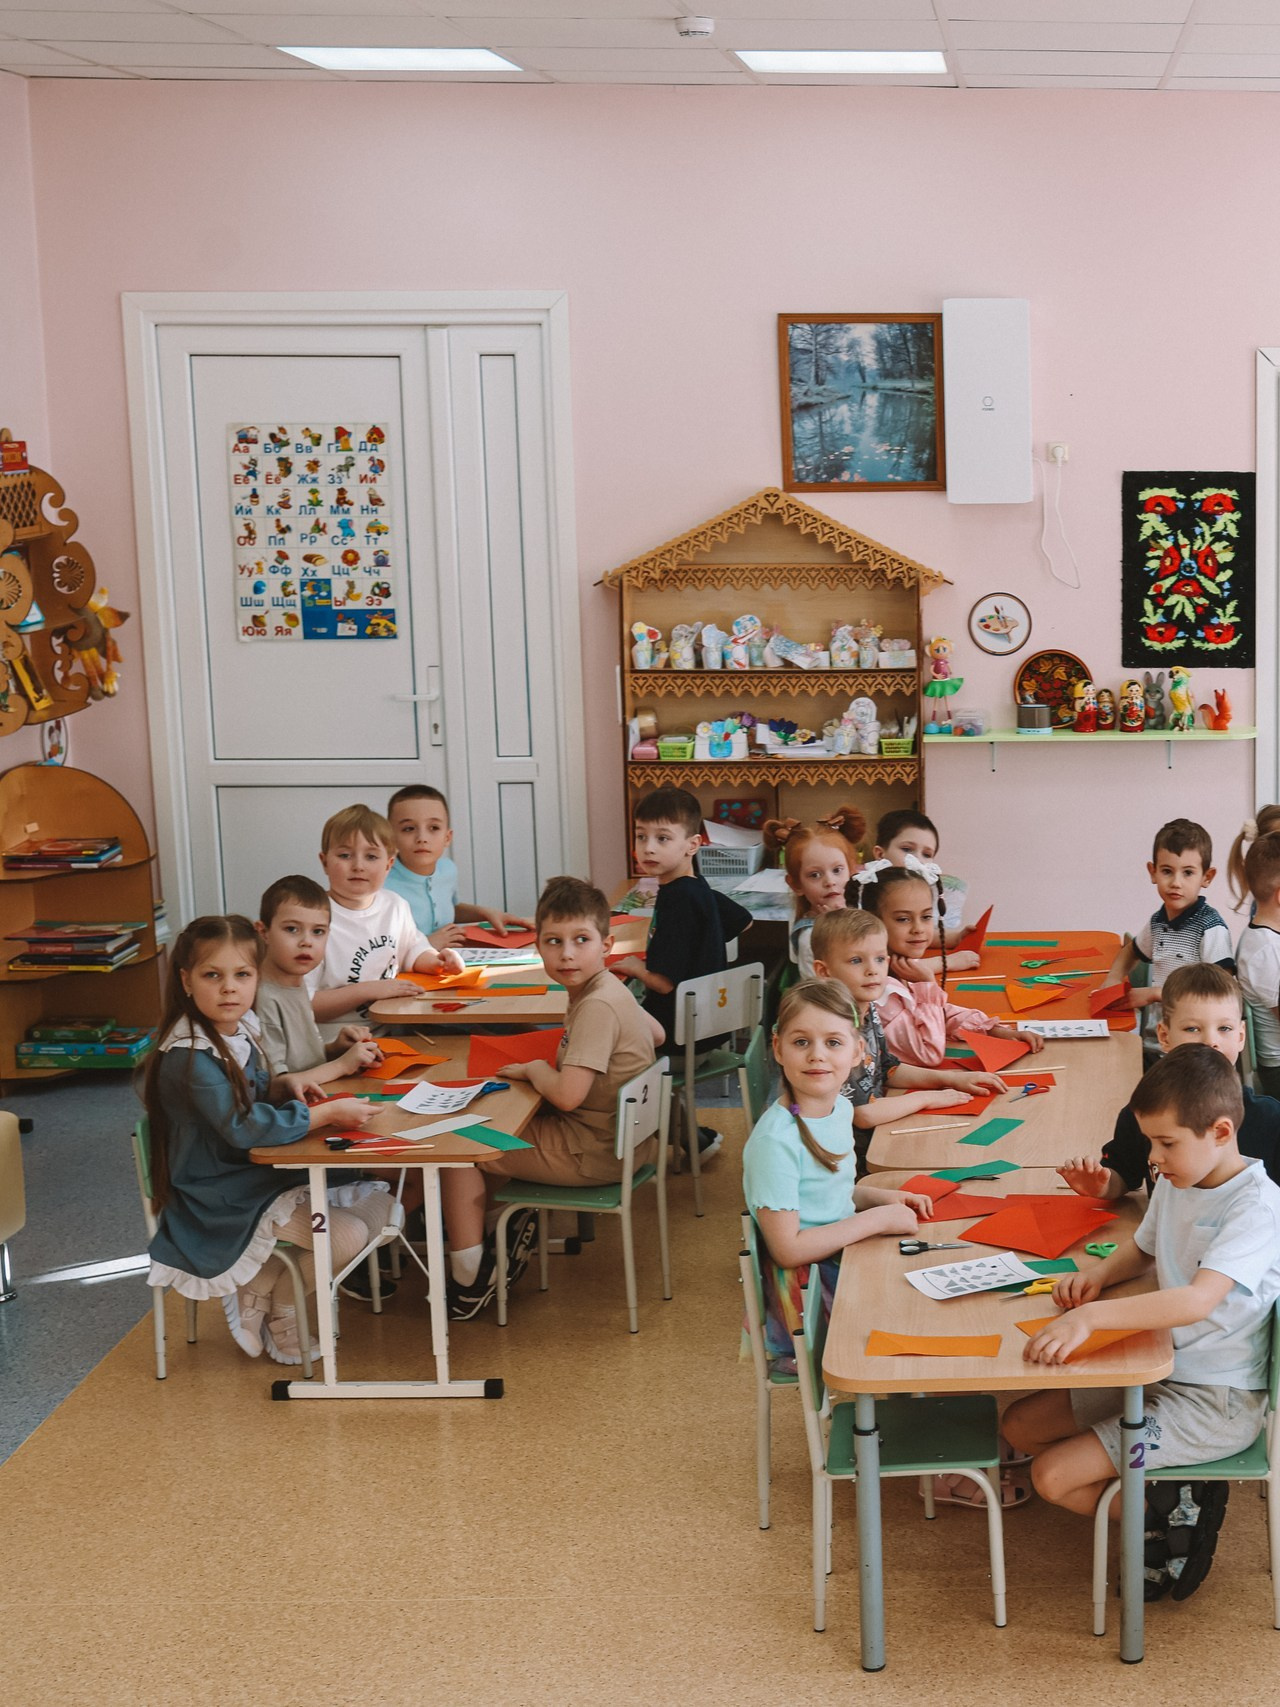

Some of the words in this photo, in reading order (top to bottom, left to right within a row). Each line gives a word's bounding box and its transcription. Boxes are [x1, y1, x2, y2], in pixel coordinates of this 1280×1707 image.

[232, 443, 250, 454] Аа
[295, 443, 313, 454] Вв
[297, 474, 320, 485] Жж
[298, 505, 317, 515] Лл
[330, 505, 351, 515] Мм
[361, 505, 379, 515] Нн
[268, 535, 286, 546] Пп
[300, 533, 317, 546] Рр
[364, 535, 380, 546] Тт
[238, 564, 254, 578] Уу
[269, 565, 292, 576] Фф
[301, 567, 317, 577] Хх
[332, 565, 350, 577] Цц
[363, 566, 380, 576] Чч
[240, 597, 265, 607] Шш
[272, 597, 297, 609] Щщ
[242, 626, 268, 636] Юю
[274, 626, 293, 636] Яя
[347, 946, 370, 984] KAPPA
[717, 988, 728, 1008] 3
[641, 1084, 649, 1105] 2
[311, 1212, 327, 1233] 2
[1129, 1442, 1145, 1469] 2
